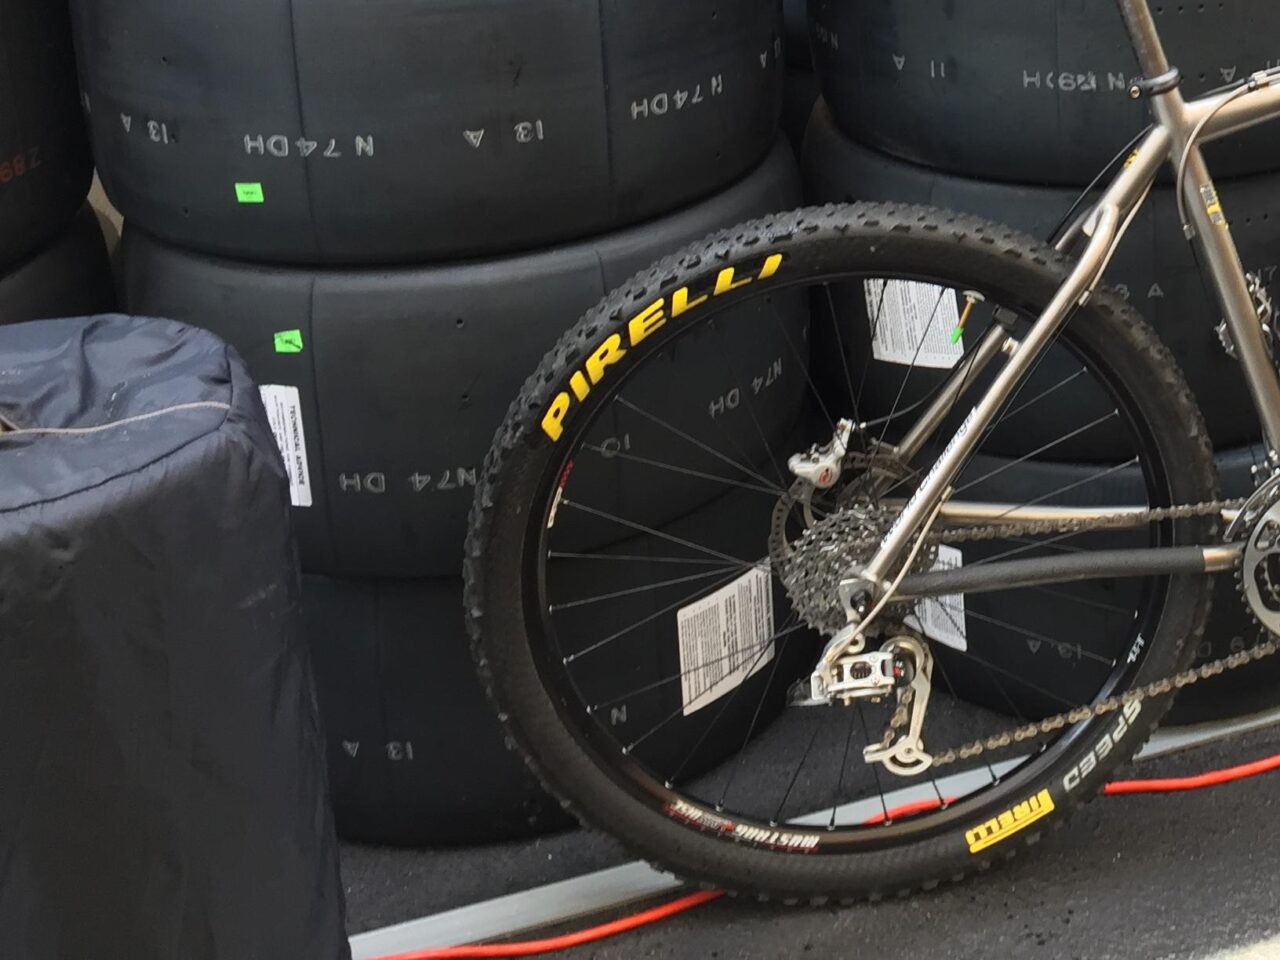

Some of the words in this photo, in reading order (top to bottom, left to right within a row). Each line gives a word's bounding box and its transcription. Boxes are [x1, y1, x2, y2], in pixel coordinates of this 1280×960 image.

[541, 252, 784, 443] PIRELLI
[338, 468, 386, 494] DH
[1062, 702, 1142, 791] SPEED
